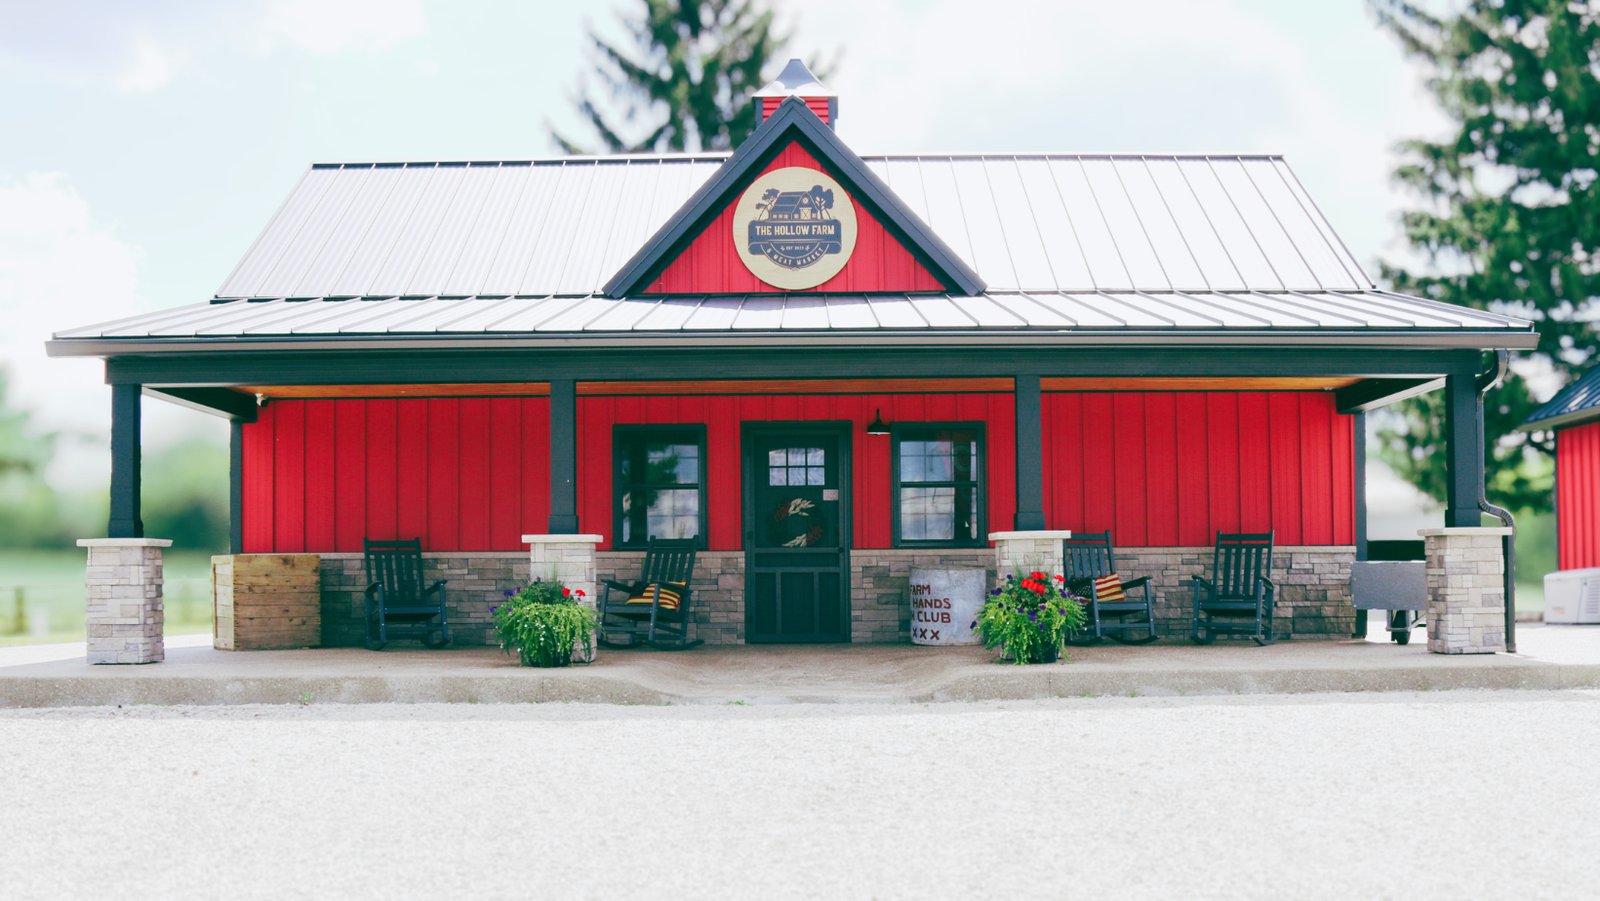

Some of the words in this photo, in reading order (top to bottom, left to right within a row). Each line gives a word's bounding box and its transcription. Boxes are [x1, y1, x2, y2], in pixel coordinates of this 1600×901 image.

[755, 225, 772, 235] THE
[774, 225, 810, 235] HOLLOW
[812, 225, 834, 235] FARM
[773, 254, 792, 265] MEAT
[796, 247, 824, 265] MARKET
[912, 598, 951, 609] HANDS
[917, 611, 951, 623] CLUB
